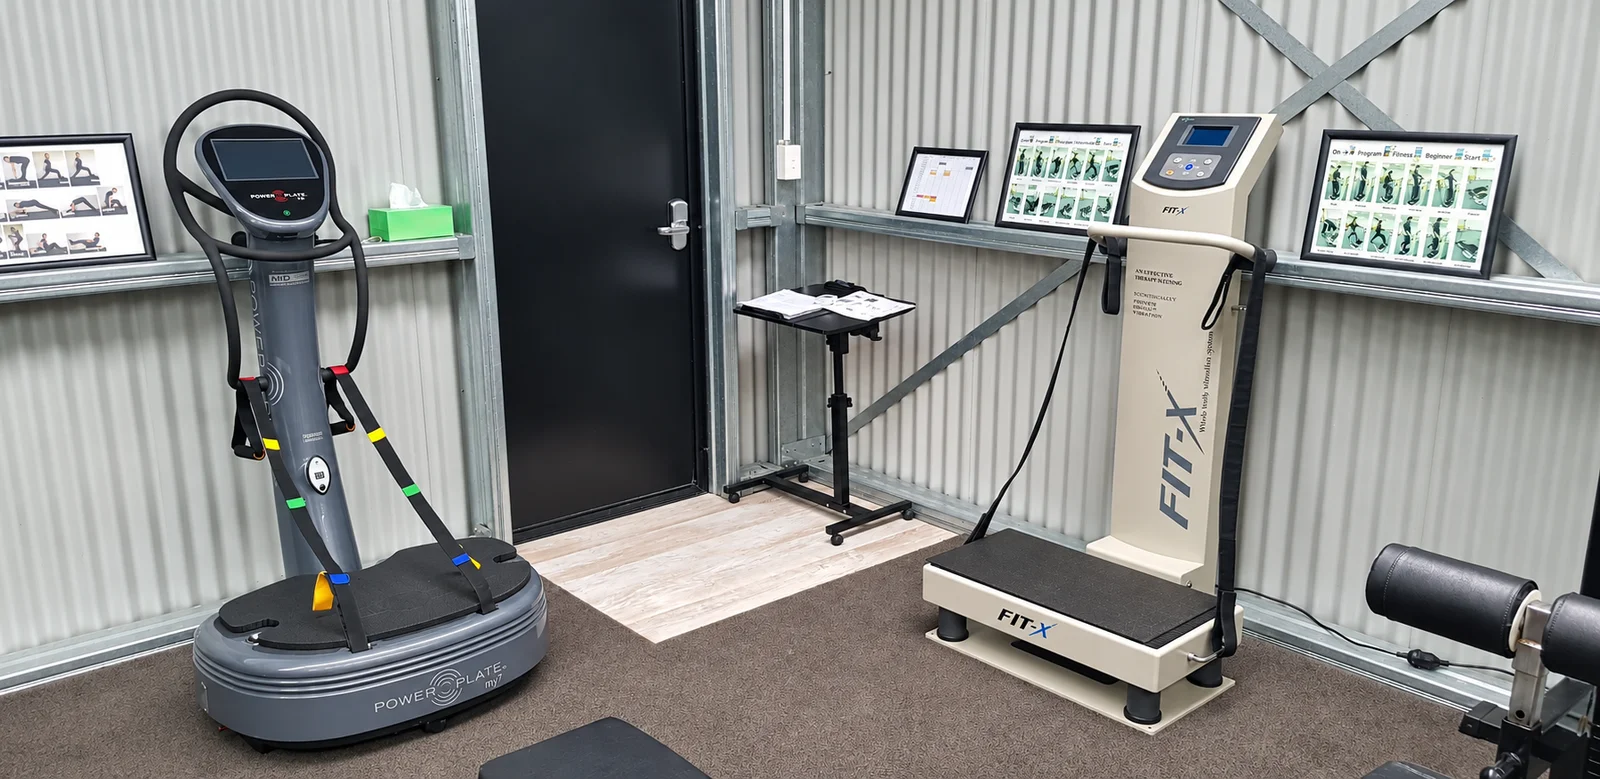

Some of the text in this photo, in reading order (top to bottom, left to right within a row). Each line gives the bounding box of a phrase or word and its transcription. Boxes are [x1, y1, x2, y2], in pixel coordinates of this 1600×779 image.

[1357, 150, 1382, 158] Program
[1425, 153, 1453, 161] Beginner
[1162, 206, 1190, 216] FIT-X
[1156, 369, 1204, 530] FIT-X
[997, 608, 1058, 639] FIT-X
[374, 661, 502, 713] POWER PLATE
[485, 673, 503, 690] my7
